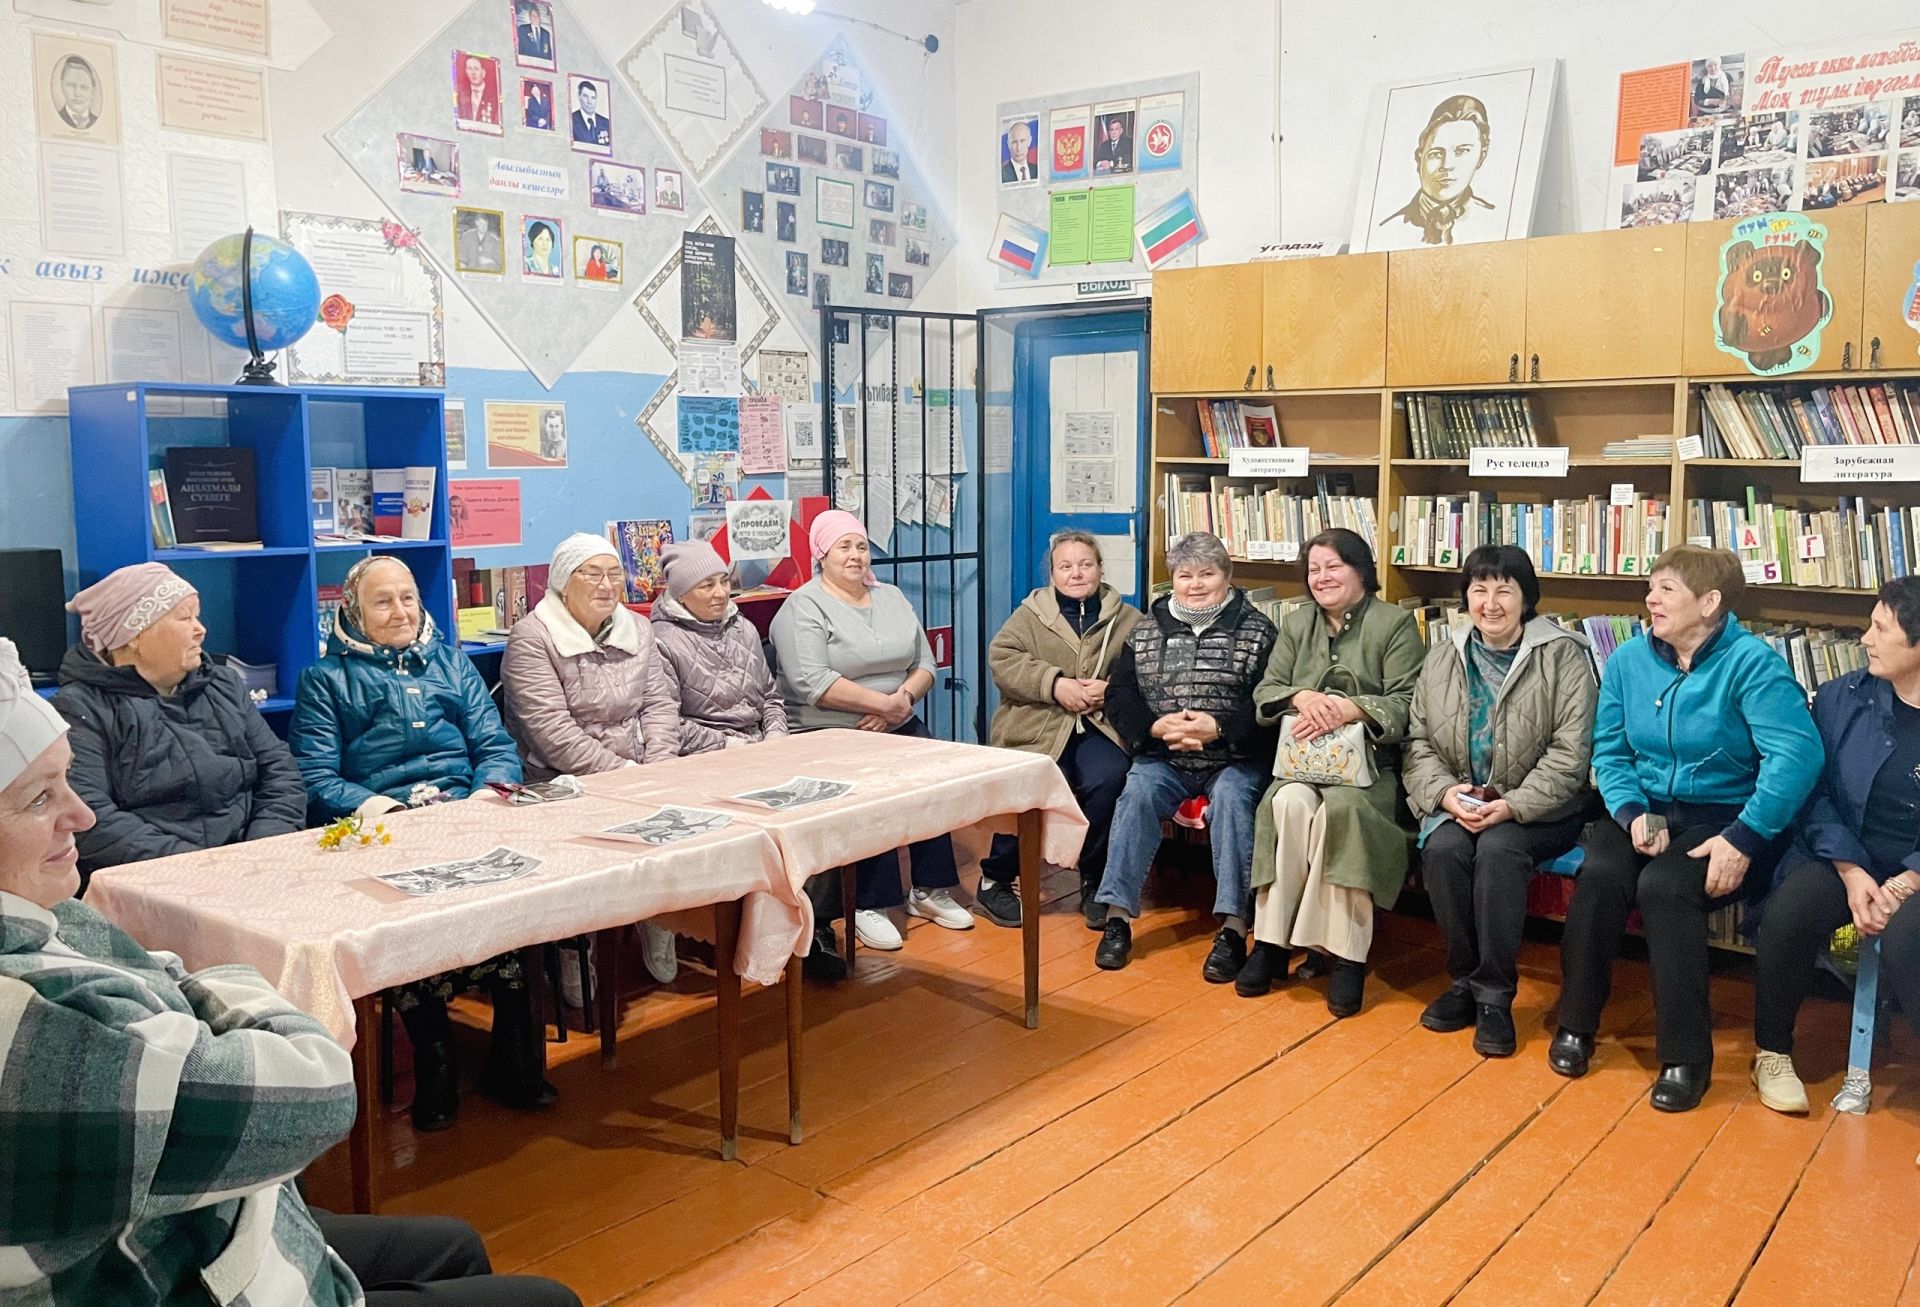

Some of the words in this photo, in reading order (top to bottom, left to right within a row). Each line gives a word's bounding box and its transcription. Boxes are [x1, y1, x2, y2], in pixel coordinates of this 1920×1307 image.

[1754, 55, 1818, 88] Туган
[1260, 241, 1325, 253] угадай
[35, 260, 104, 281] авыз
[1242, 456, 1295, 465] Художественная
[1486, 458, 1505, 470] Рус
[1508, 460, 1549, 469] телендә
[1833, 456, 1894, 467] Зарубежная
[1250, 467, 1286, 475] литература
[1833, 471, 1893, 480] литература
[740, 518, 779, 528] ПРОВЕДЁМ
[1744, 529, 1757, 546] А
[1806, 535, 1818, 556] Г
[1394, 548, 1405, 563] А
[1440, 550, 1452, 564] Б
[1623, 557, 1636, 573] Е
[1764, 562, 1777, 580] Б
